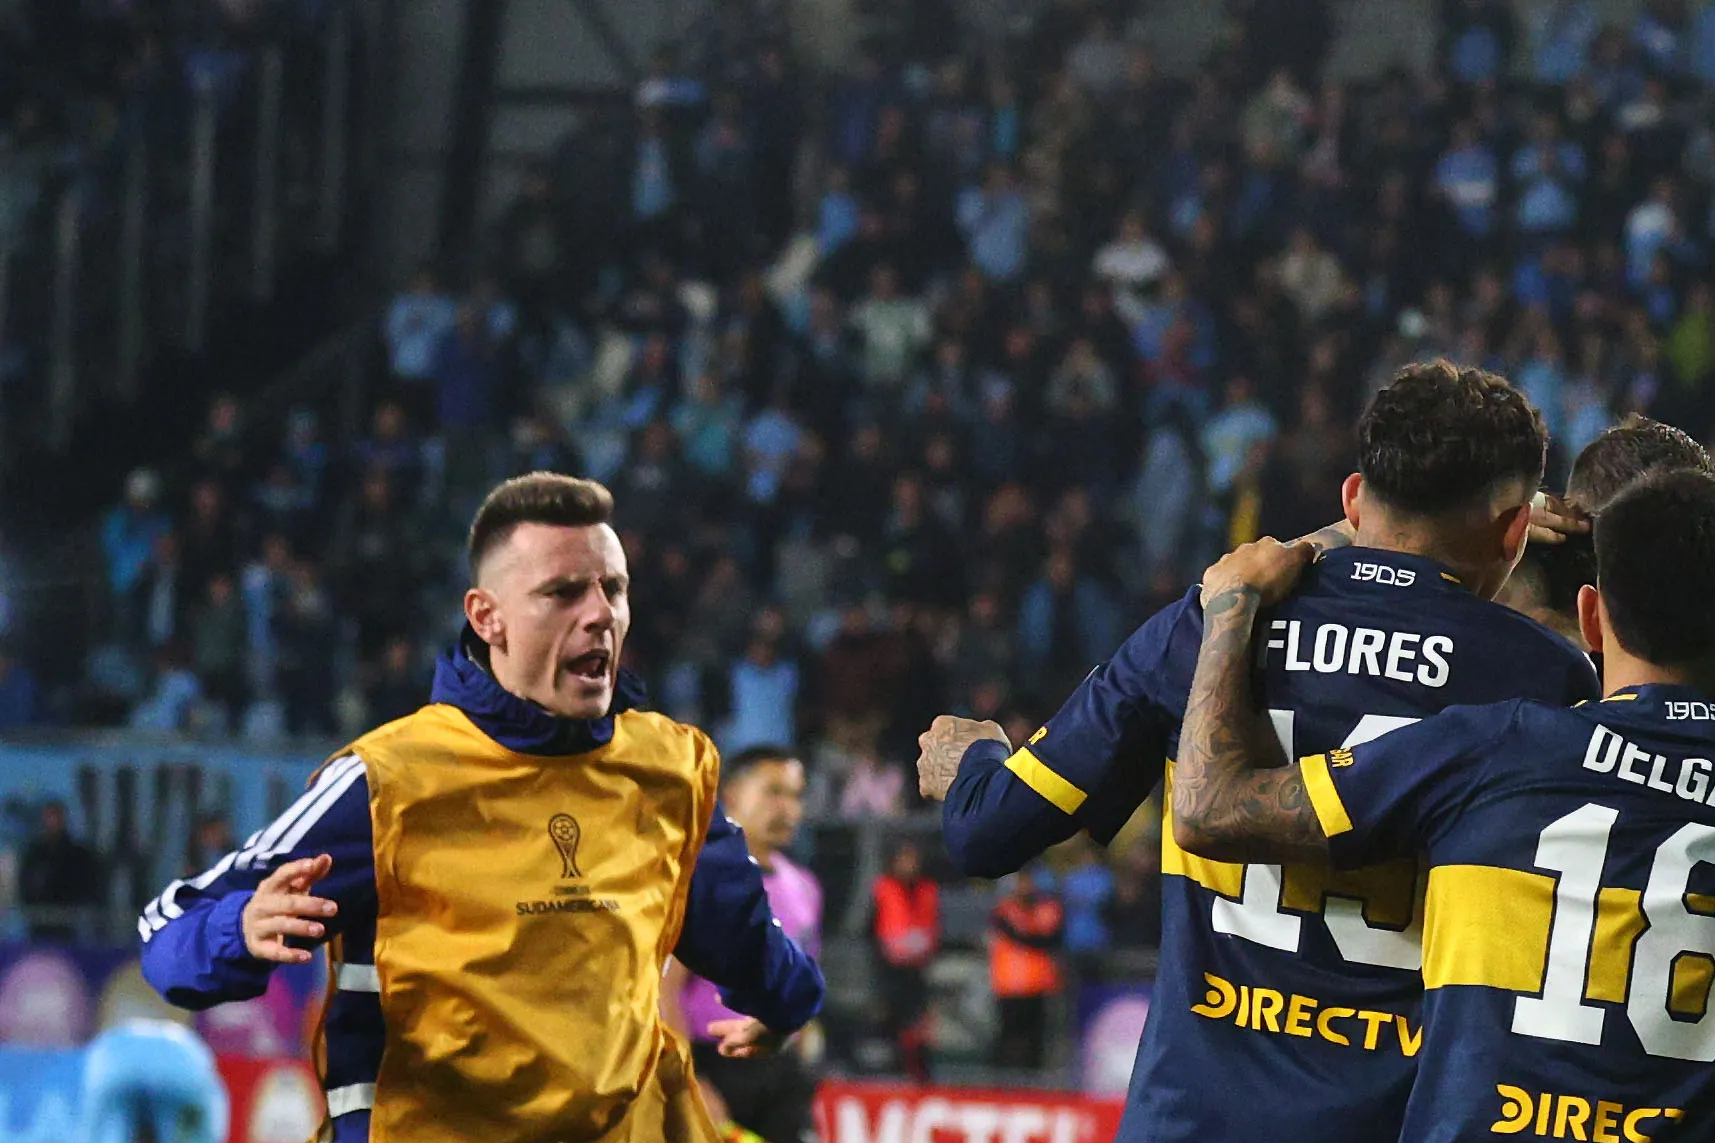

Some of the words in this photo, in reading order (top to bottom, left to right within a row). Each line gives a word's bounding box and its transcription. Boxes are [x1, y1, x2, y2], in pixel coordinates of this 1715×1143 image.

[1350, 562, 1416, 587] 1905
[1265, 620, 1454, 688] FLORES
[1190, 972, 1423, 1057] DIRECTV
